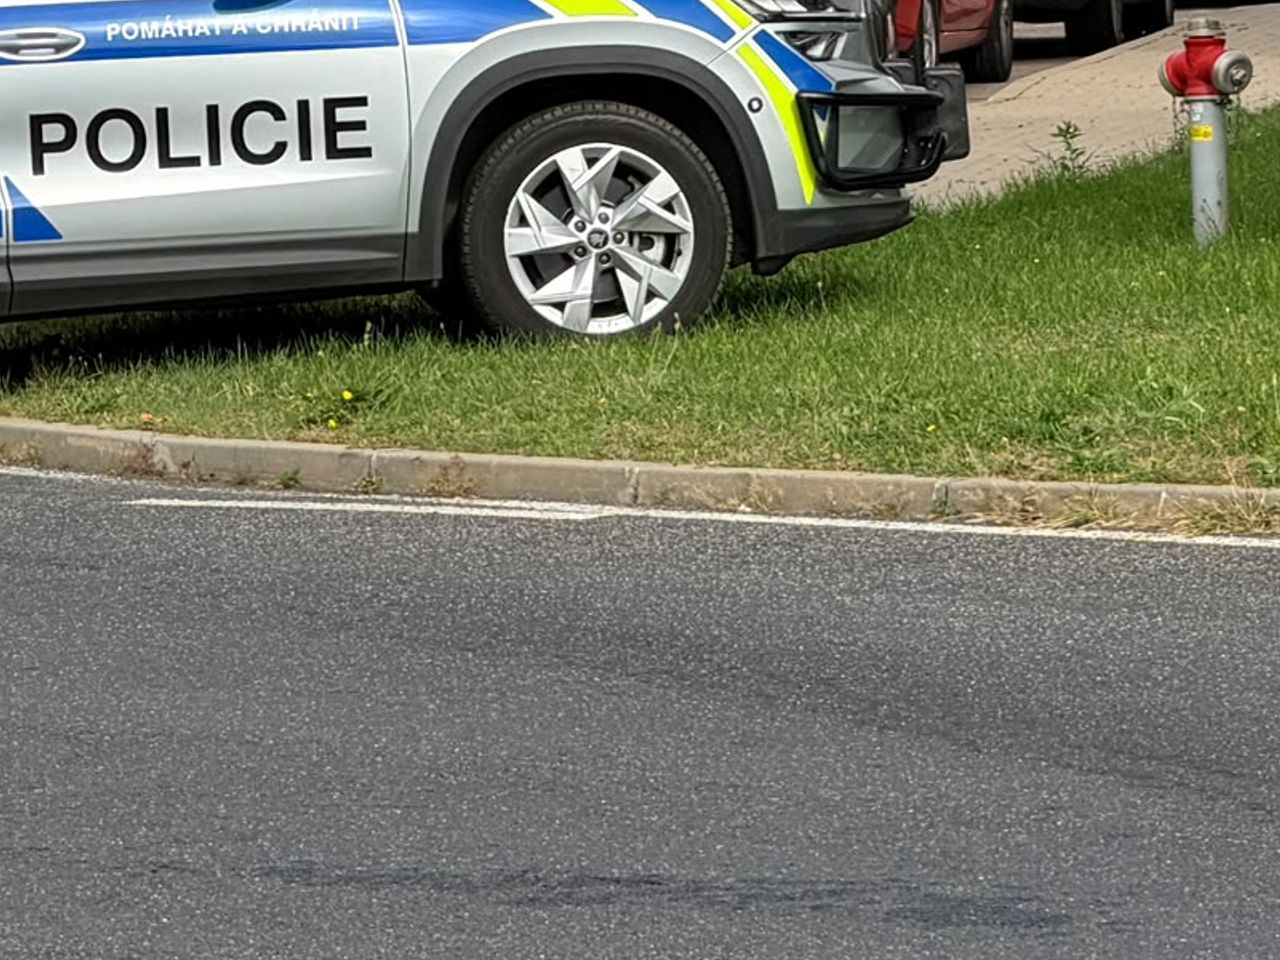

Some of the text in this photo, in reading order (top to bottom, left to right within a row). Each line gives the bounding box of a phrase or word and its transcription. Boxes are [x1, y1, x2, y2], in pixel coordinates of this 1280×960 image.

[106, 15, 222, 41] POMÁHAT
[232, 20, 248, 35] A
[29, 96, 372, 176] POLICIE
